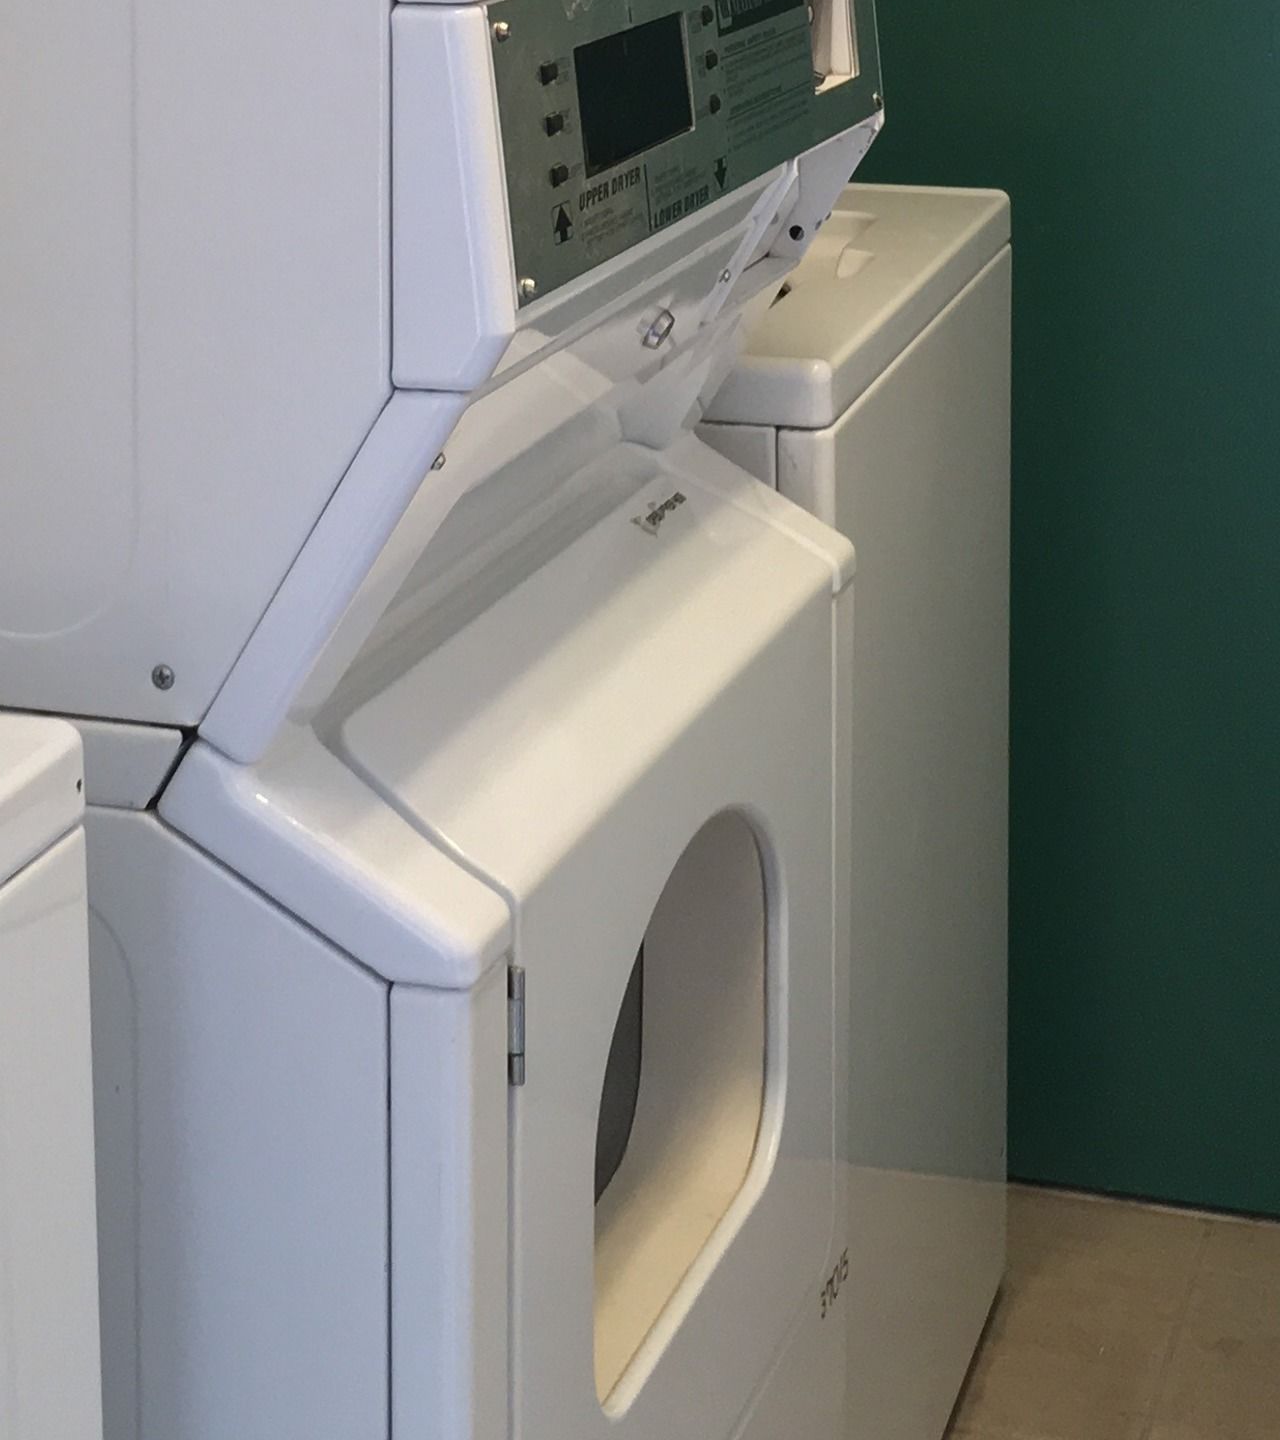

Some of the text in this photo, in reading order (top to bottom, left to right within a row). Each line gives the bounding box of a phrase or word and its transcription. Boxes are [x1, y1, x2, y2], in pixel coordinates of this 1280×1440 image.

[578, 180, 609, 211] UPPER
[611, 166, 641, 195] DRYER
[653, 199, 682, 229] LOWER
[684, 184, 710, 212] DRYER
